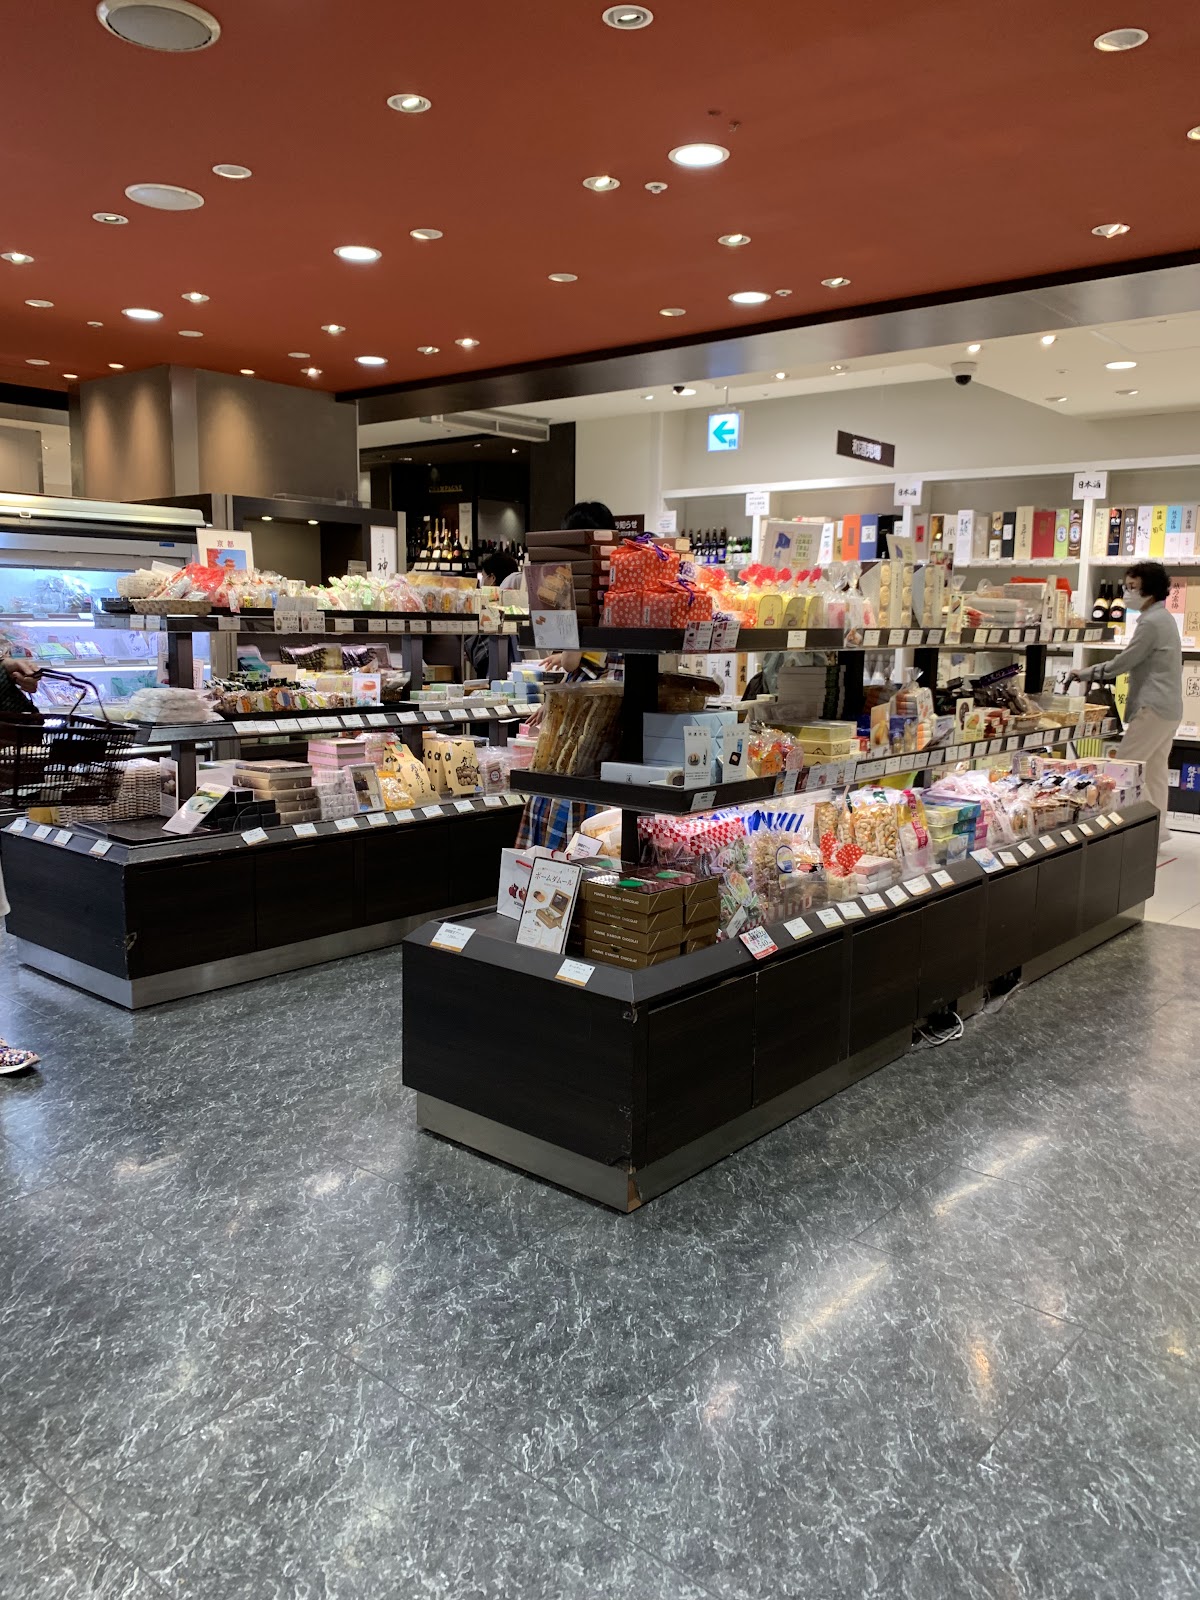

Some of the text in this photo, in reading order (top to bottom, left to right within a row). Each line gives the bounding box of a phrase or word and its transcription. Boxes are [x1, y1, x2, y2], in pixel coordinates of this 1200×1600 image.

[1078, 480, 1101, 489] 日本酒
[898, 488, 917, 496] 日本酒
[217, 539, 235, 549] 京都
